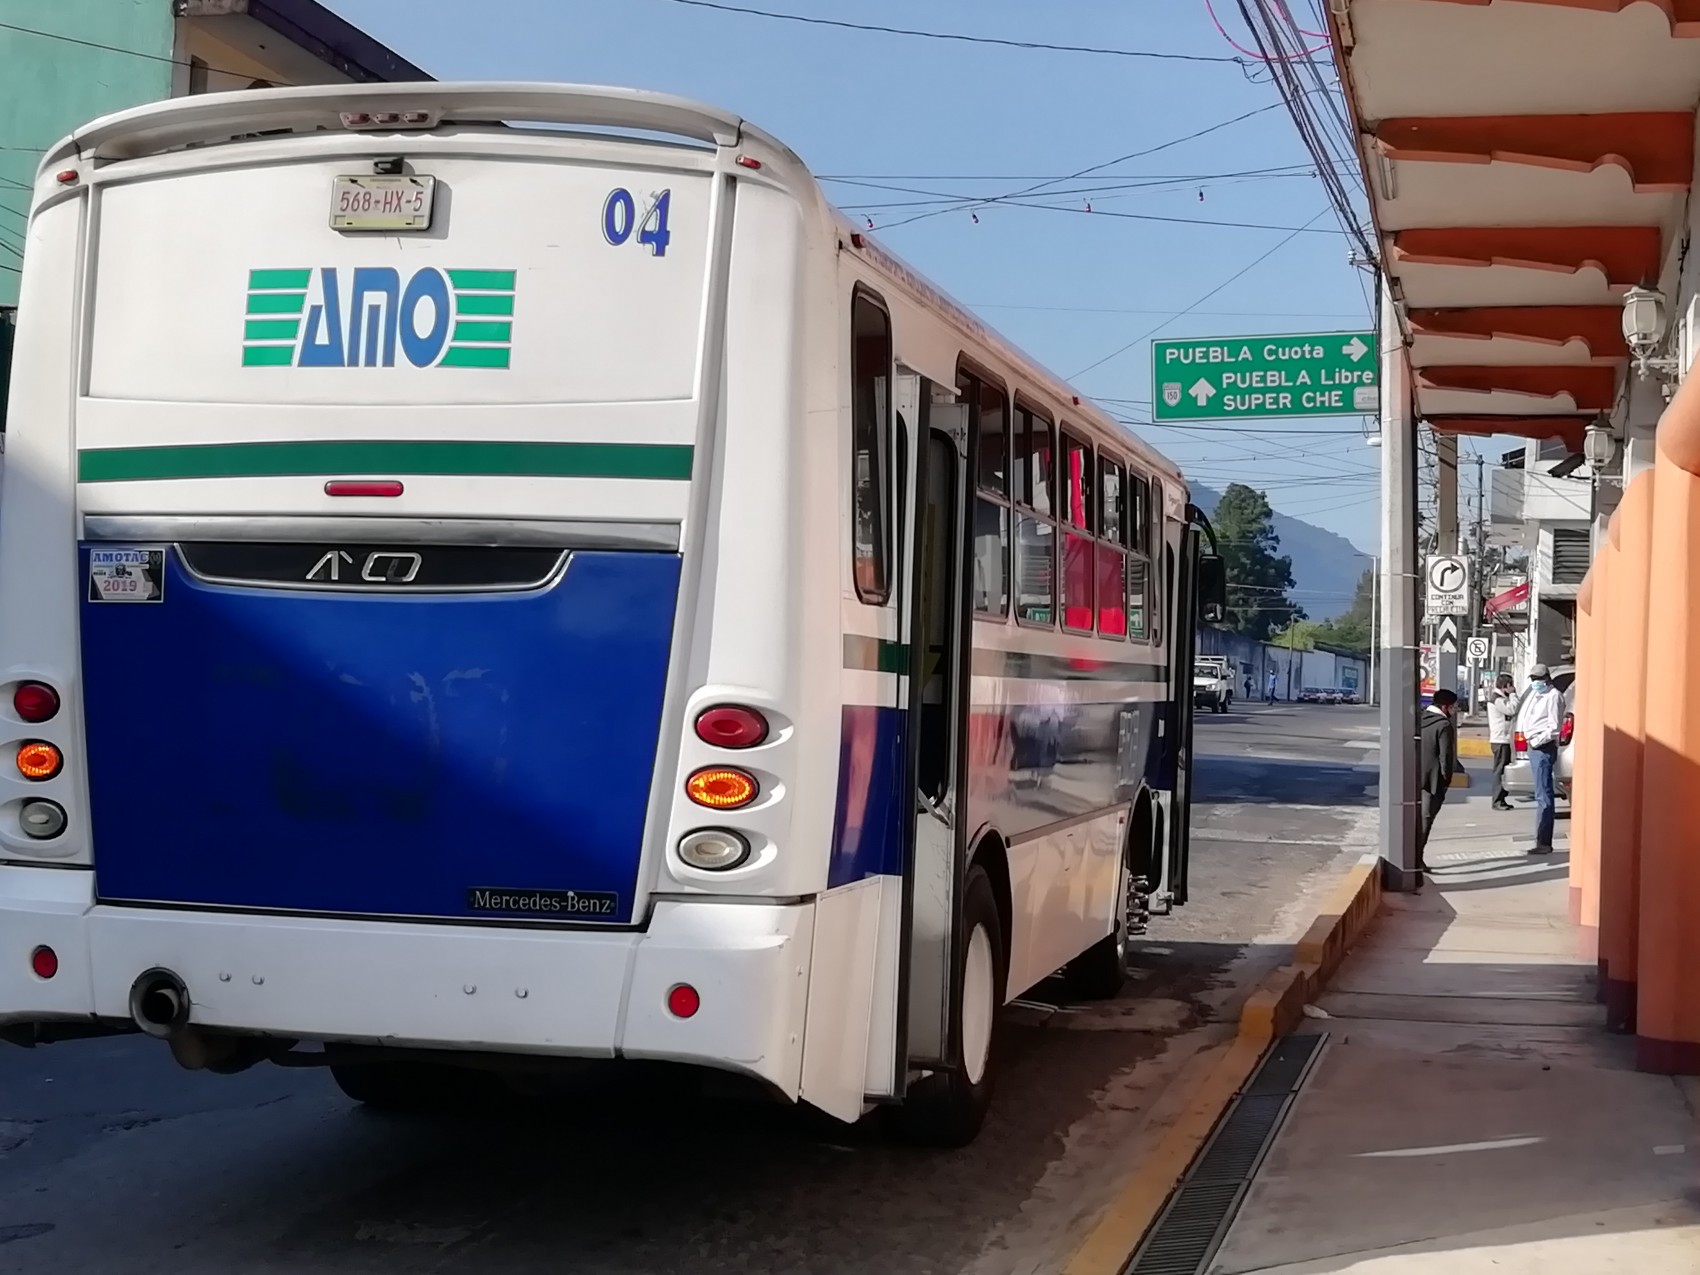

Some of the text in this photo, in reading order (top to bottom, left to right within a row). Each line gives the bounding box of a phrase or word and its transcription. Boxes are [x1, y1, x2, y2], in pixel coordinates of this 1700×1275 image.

[340, 190, 424, 213] 568-HX-5
[601, 187, 671, 257] 04
[297, 266, 450, 368] AMO
[1165, 343, 1324, 364] PUEBLA Cuota
[1222, 368, 1374, 388] PUEBLA Libre
[1166, 391, 1178, 401] 150
[1223, 391, 1343, 411] SUPER CHE
[103, 580, 137, 592] 2019
[474, 890, 611, 913] Mercedes-Benz
